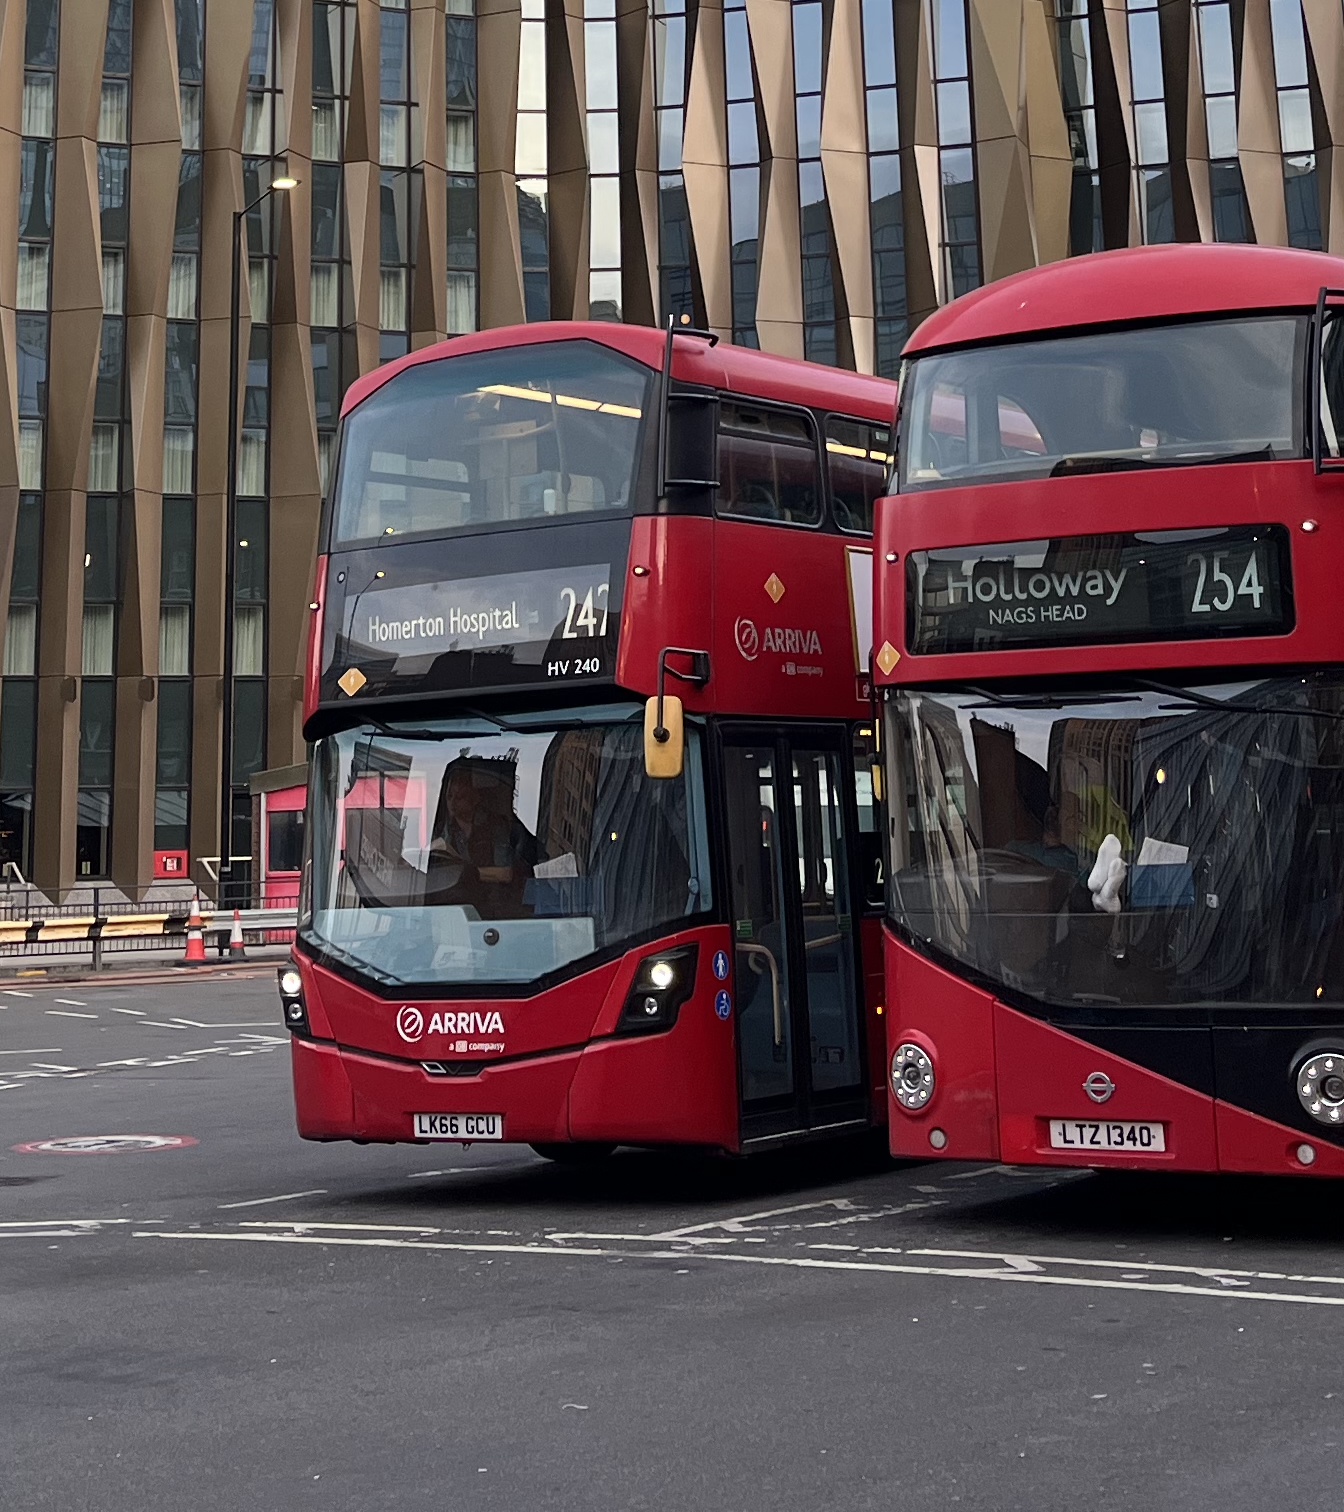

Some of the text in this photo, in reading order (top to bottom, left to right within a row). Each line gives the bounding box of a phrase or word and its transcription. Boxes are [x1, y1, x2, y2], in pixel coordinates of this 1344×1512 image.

[946, 567, 1127, 606] Holloway
[1187, 549, 1264, 613] 254
[368, 615, 444, 642] Homerton
[449, 600, 520, 640] Hospital
[989, 603, 1087, 625] NAGS HEAD
[762, 627, 823, 655] ARRIVA
[547, 657, 600, 676] HV 240
[427, 1011, 505, 1035] ARRIVA
[418, 1115, 496, 1135] LK66 GCU
[1062, 1123, 1152, 1147] LTZ 1340
